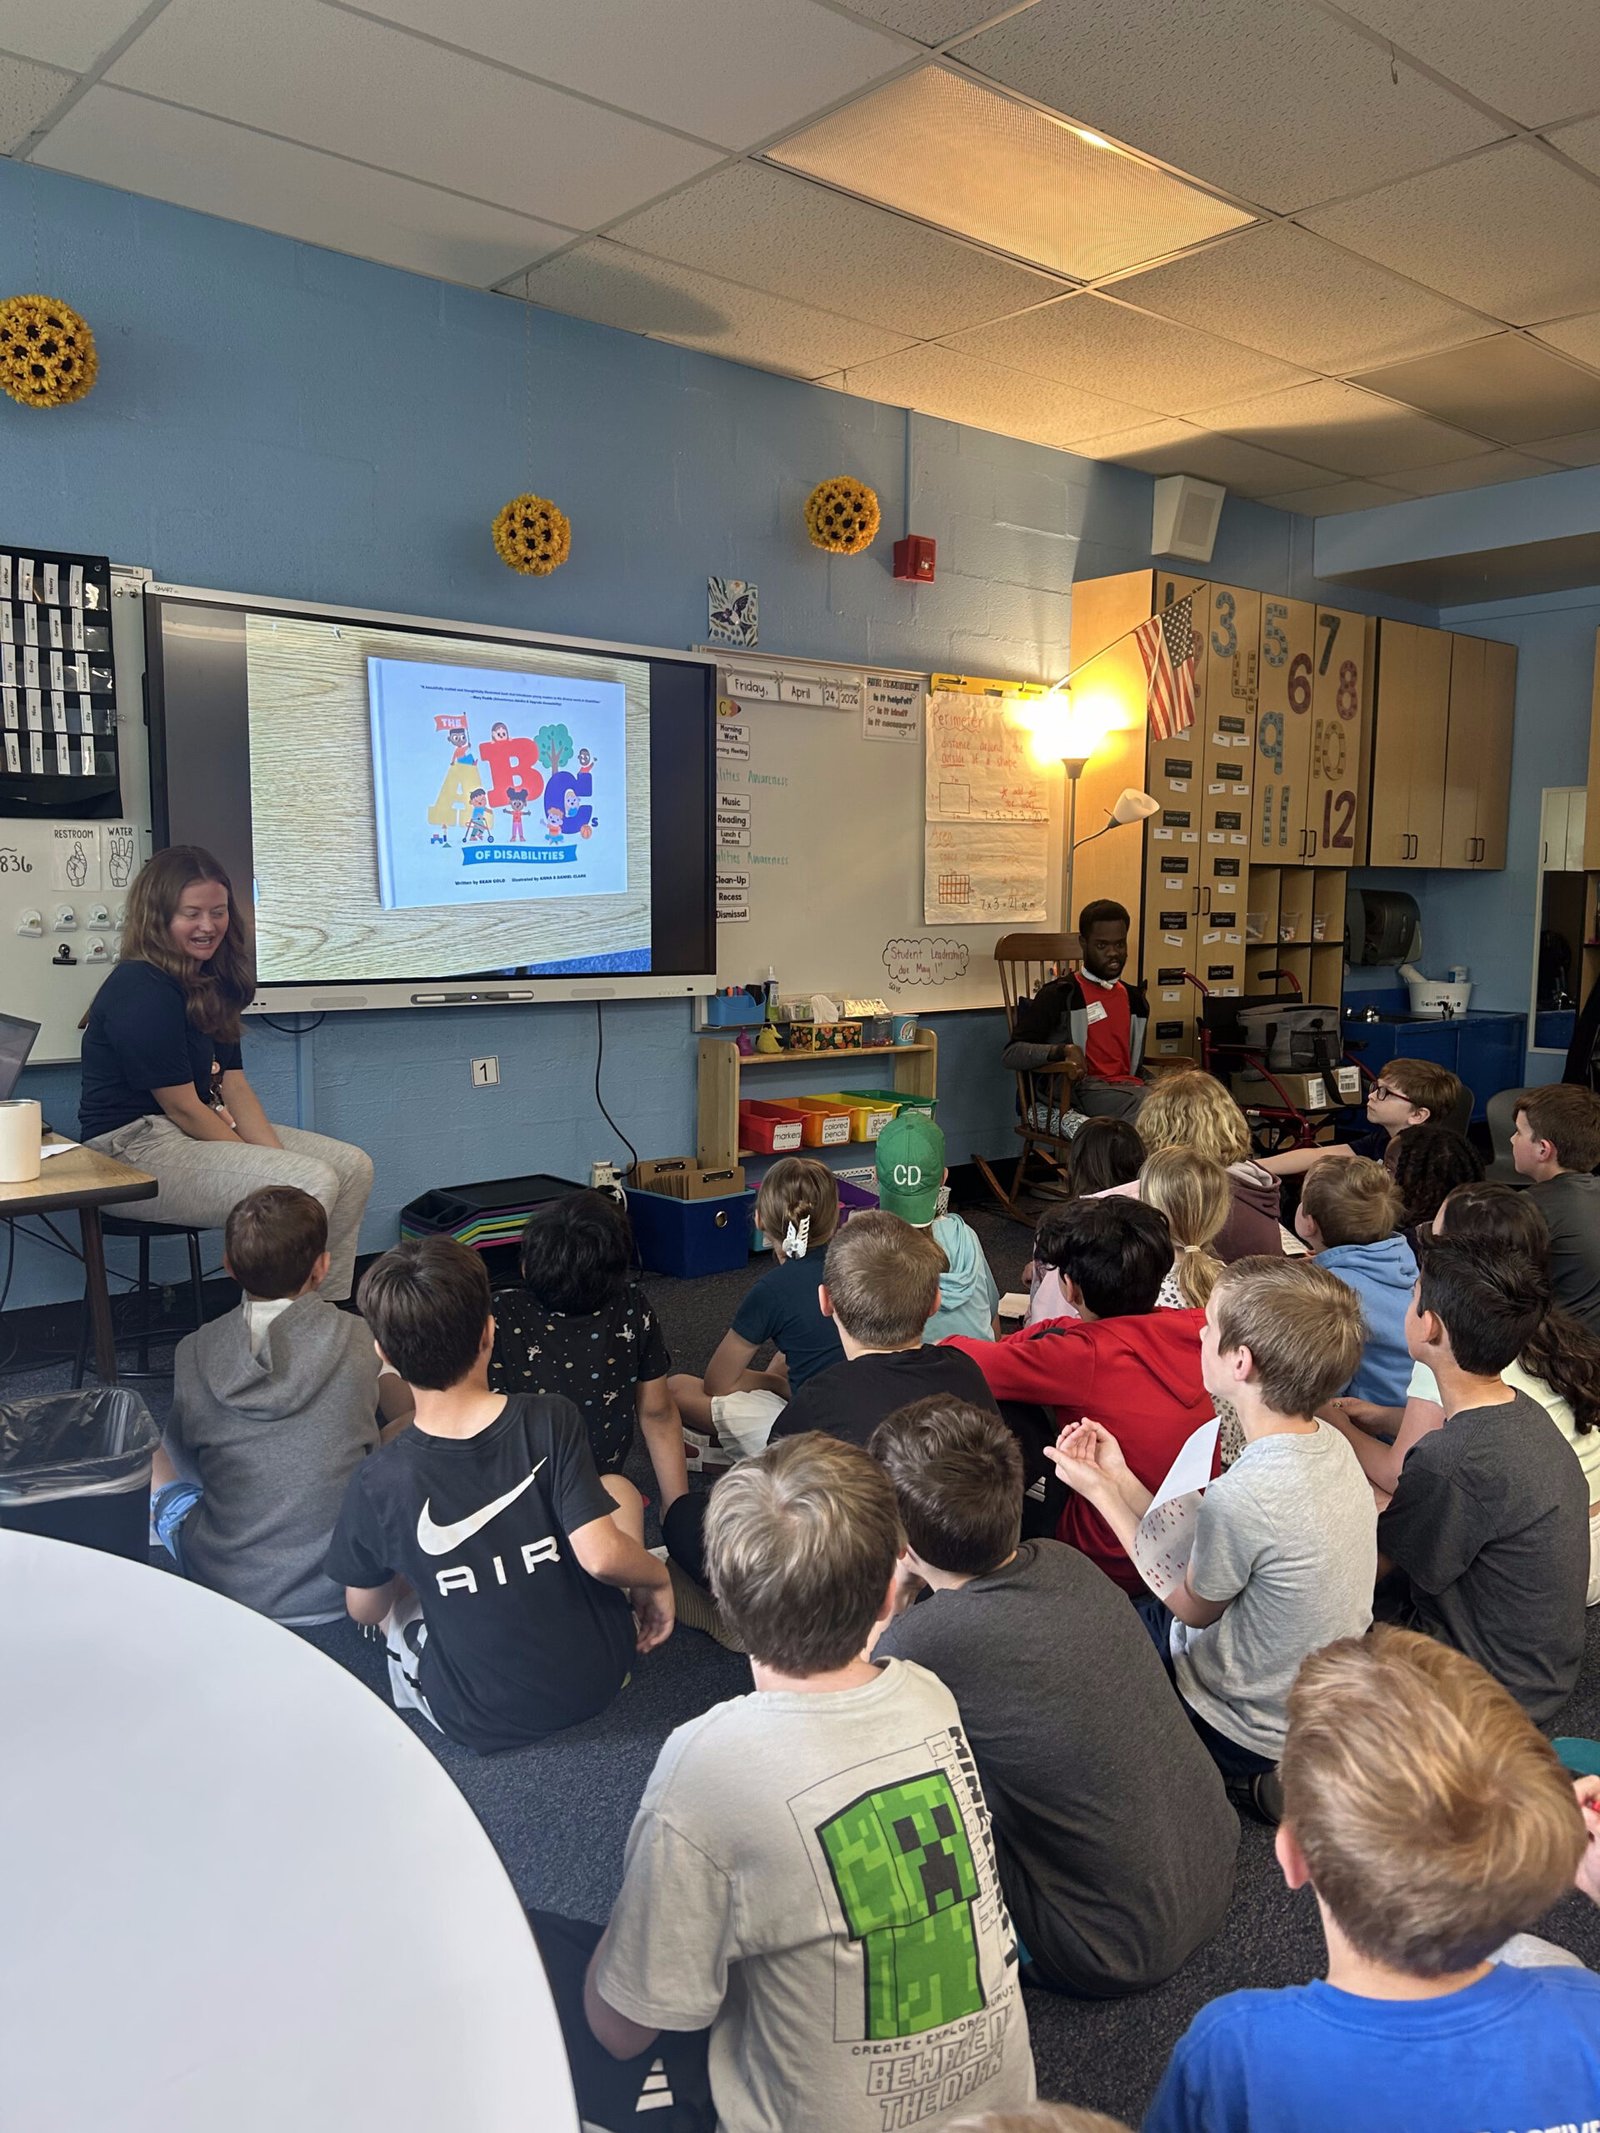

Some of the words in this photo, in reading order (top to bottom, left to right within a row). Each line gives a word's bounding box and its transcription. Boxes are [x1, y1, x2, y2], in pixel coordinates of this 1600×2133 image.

[154, 585, 173, 593] SMART
[1287, 653, 1313, 714] 6
[735, 679, 768, 697] Friday,
[791, 686, 811, 700] April
[840, 693, 859, 704] 2026
[1336, 660, 1358, 720] 8
[933, 704, 983, 728] Perimeter
[441, 718, 462, 727] THE
[720, 724, 742, 735] Morning
[724, 732, 738, 741] Work
[722, 796, 741, 807] Music
[718, 814, 746, 827] Reading
[1322, 789, 1356, 849] 12
[54, 829, 94, 839] RESTROOM
[107, 827, 133, 836] WATER
[721, 830, 736, 838] Lunch
[475, 850, 491, 860] OF
[493, 850, 565, 861] DISABILITIES
[719, 892, 742, 901] Recess
[994, 898, 1000, 910] 3
[716, 909, 747, 919] Dismissal
[891, 947, 923, 960] Student
[931, 948, 964, 963] Leadership
[917, 963, 931, 979] May
[480, 1063, 488, 1081] 1
[824, 1121, 848, 1131] colored
[872, 1117, 888, 1127] glue
[774, 1129, 801, 1140] markers
[824, 1128, 847, 1139] pencils
[870, 1125, 882, 1134] stic
[894, 1164, 921, 1186] CD
[435, 1535, 561, 1597] AIR
[852, 2041, 911, 2056] CREATE
[866, 2017, 987, 2096] BEWARE
[880, 2083, 940, 2133] THE
